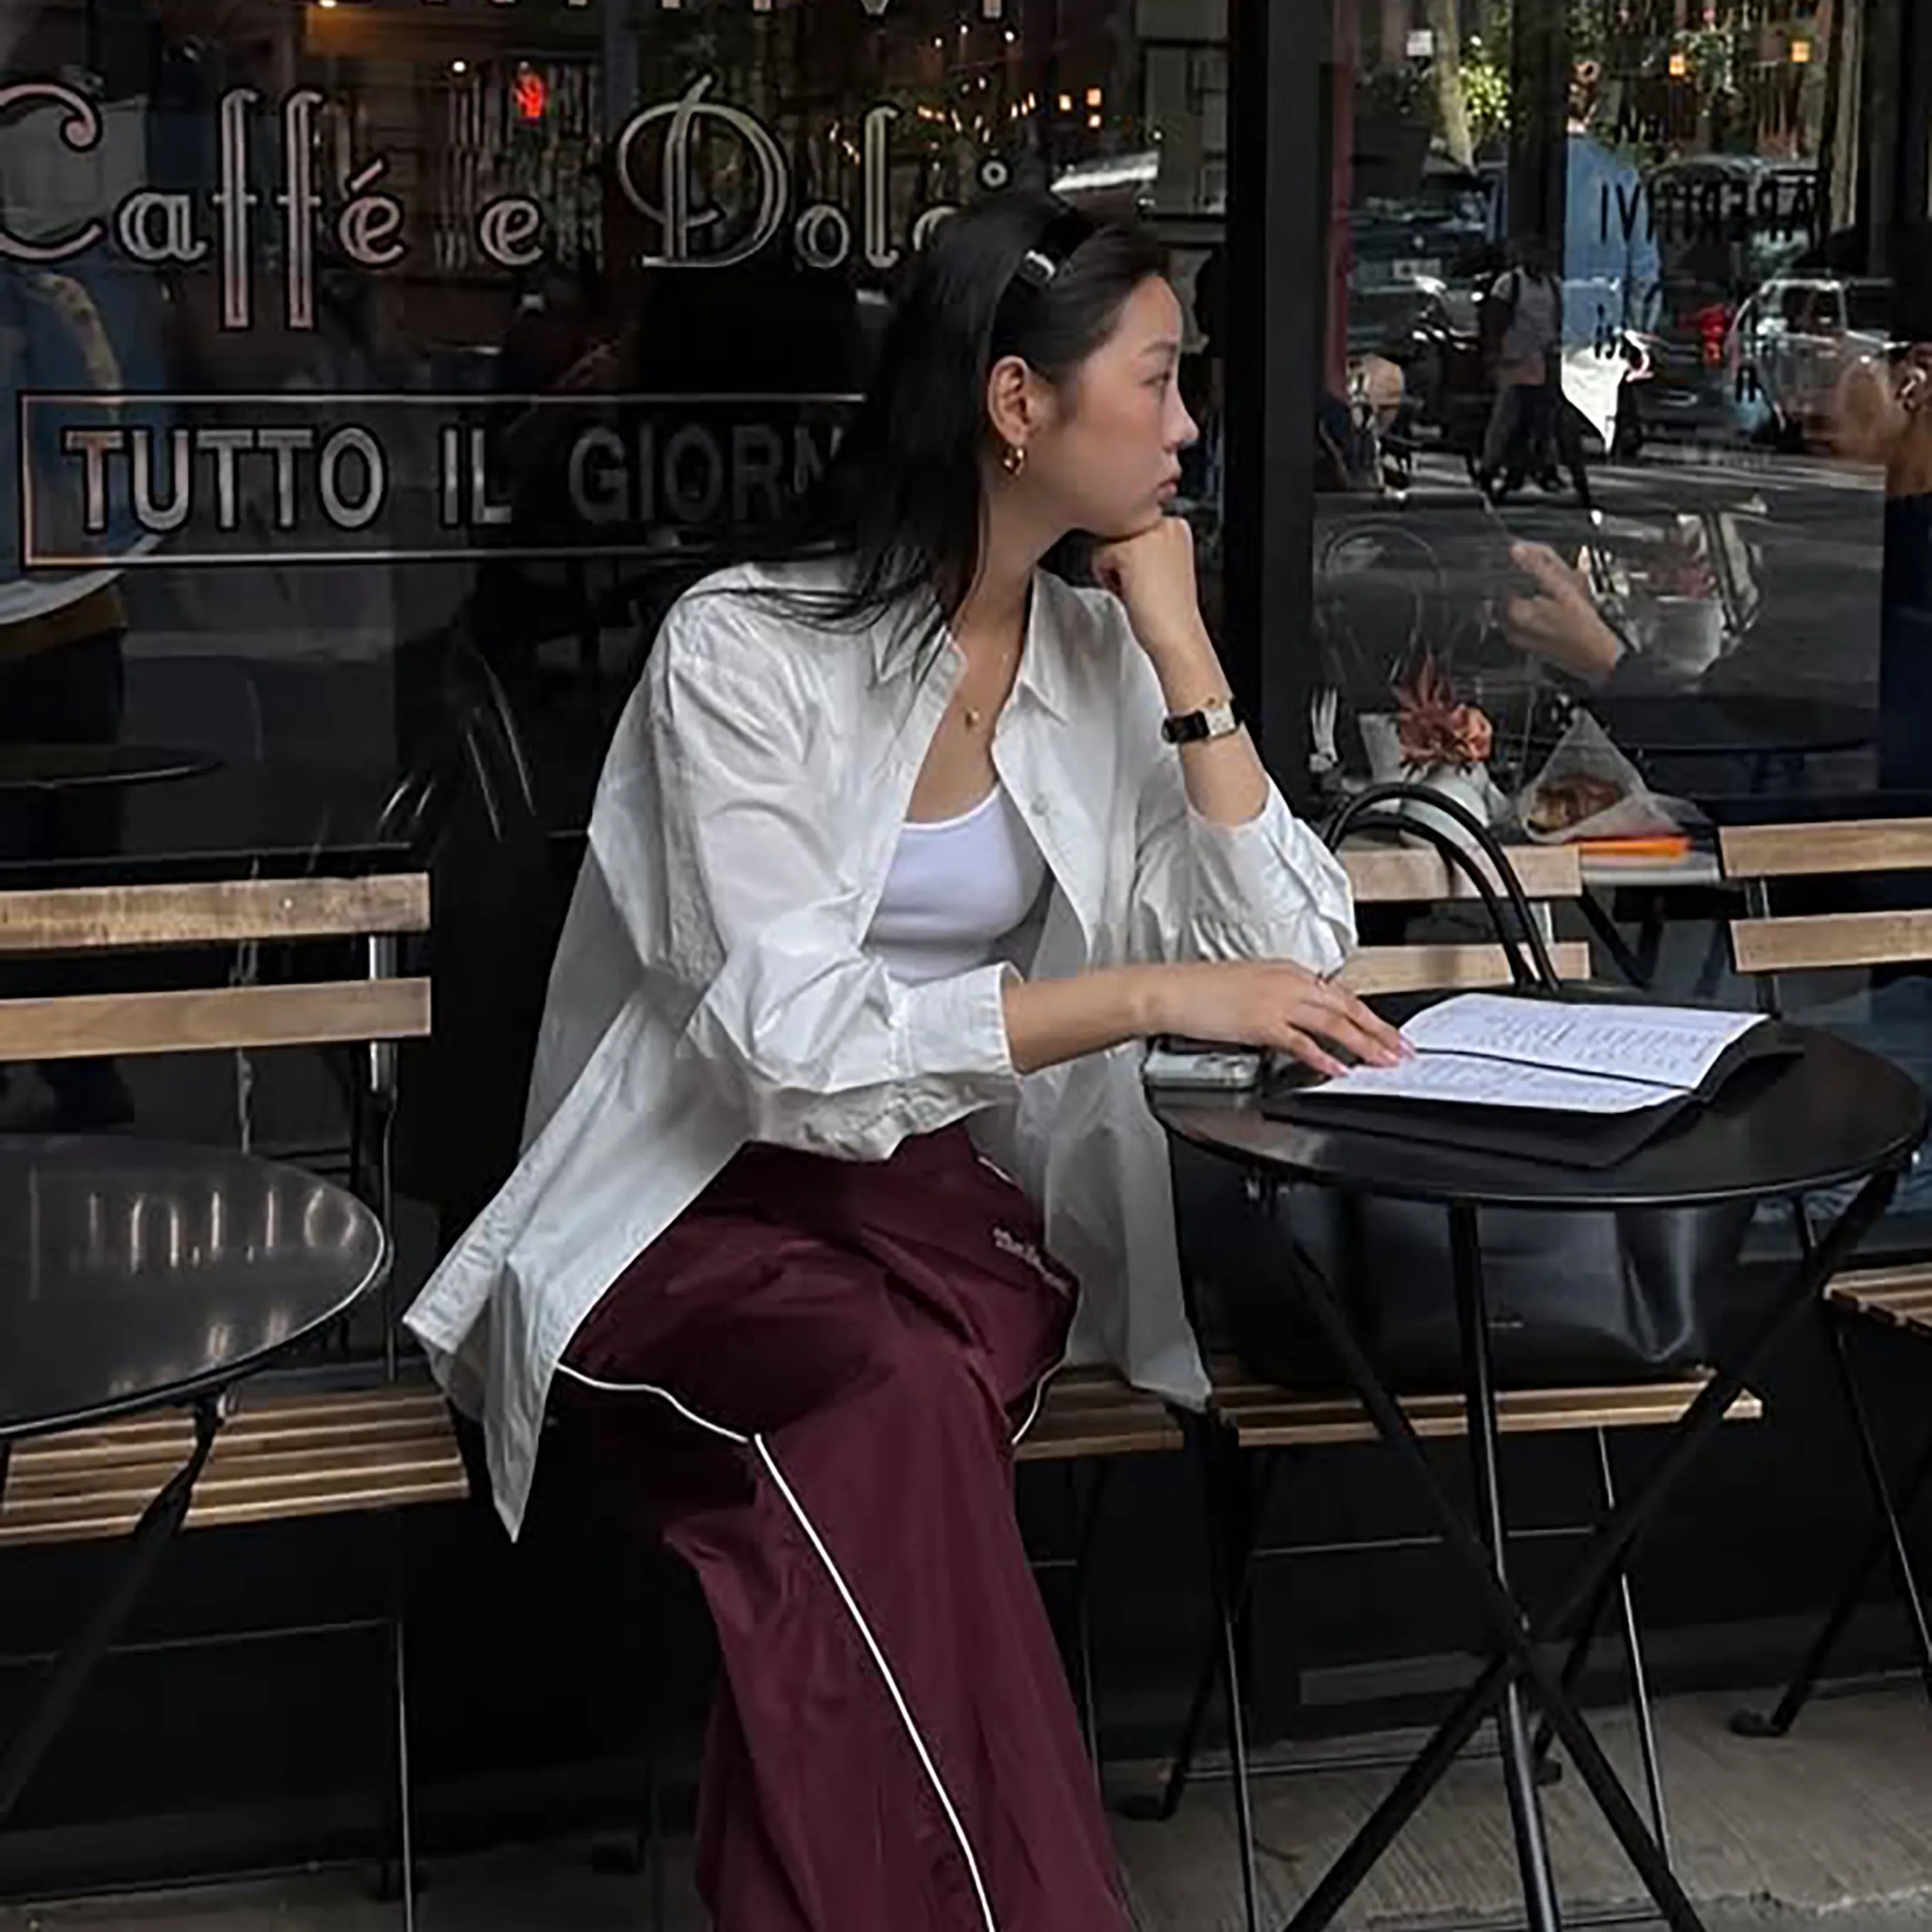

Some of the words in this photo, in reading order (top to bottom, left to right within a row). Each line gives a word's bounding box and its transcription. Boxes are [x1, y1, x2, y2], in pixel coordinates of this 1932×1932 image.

[480, 199, 543, 264] e
[617, 75, 1009, 268] Dol
[65, 427, 384, 530] TUTTO
[442, 429, 511, 524] IL
